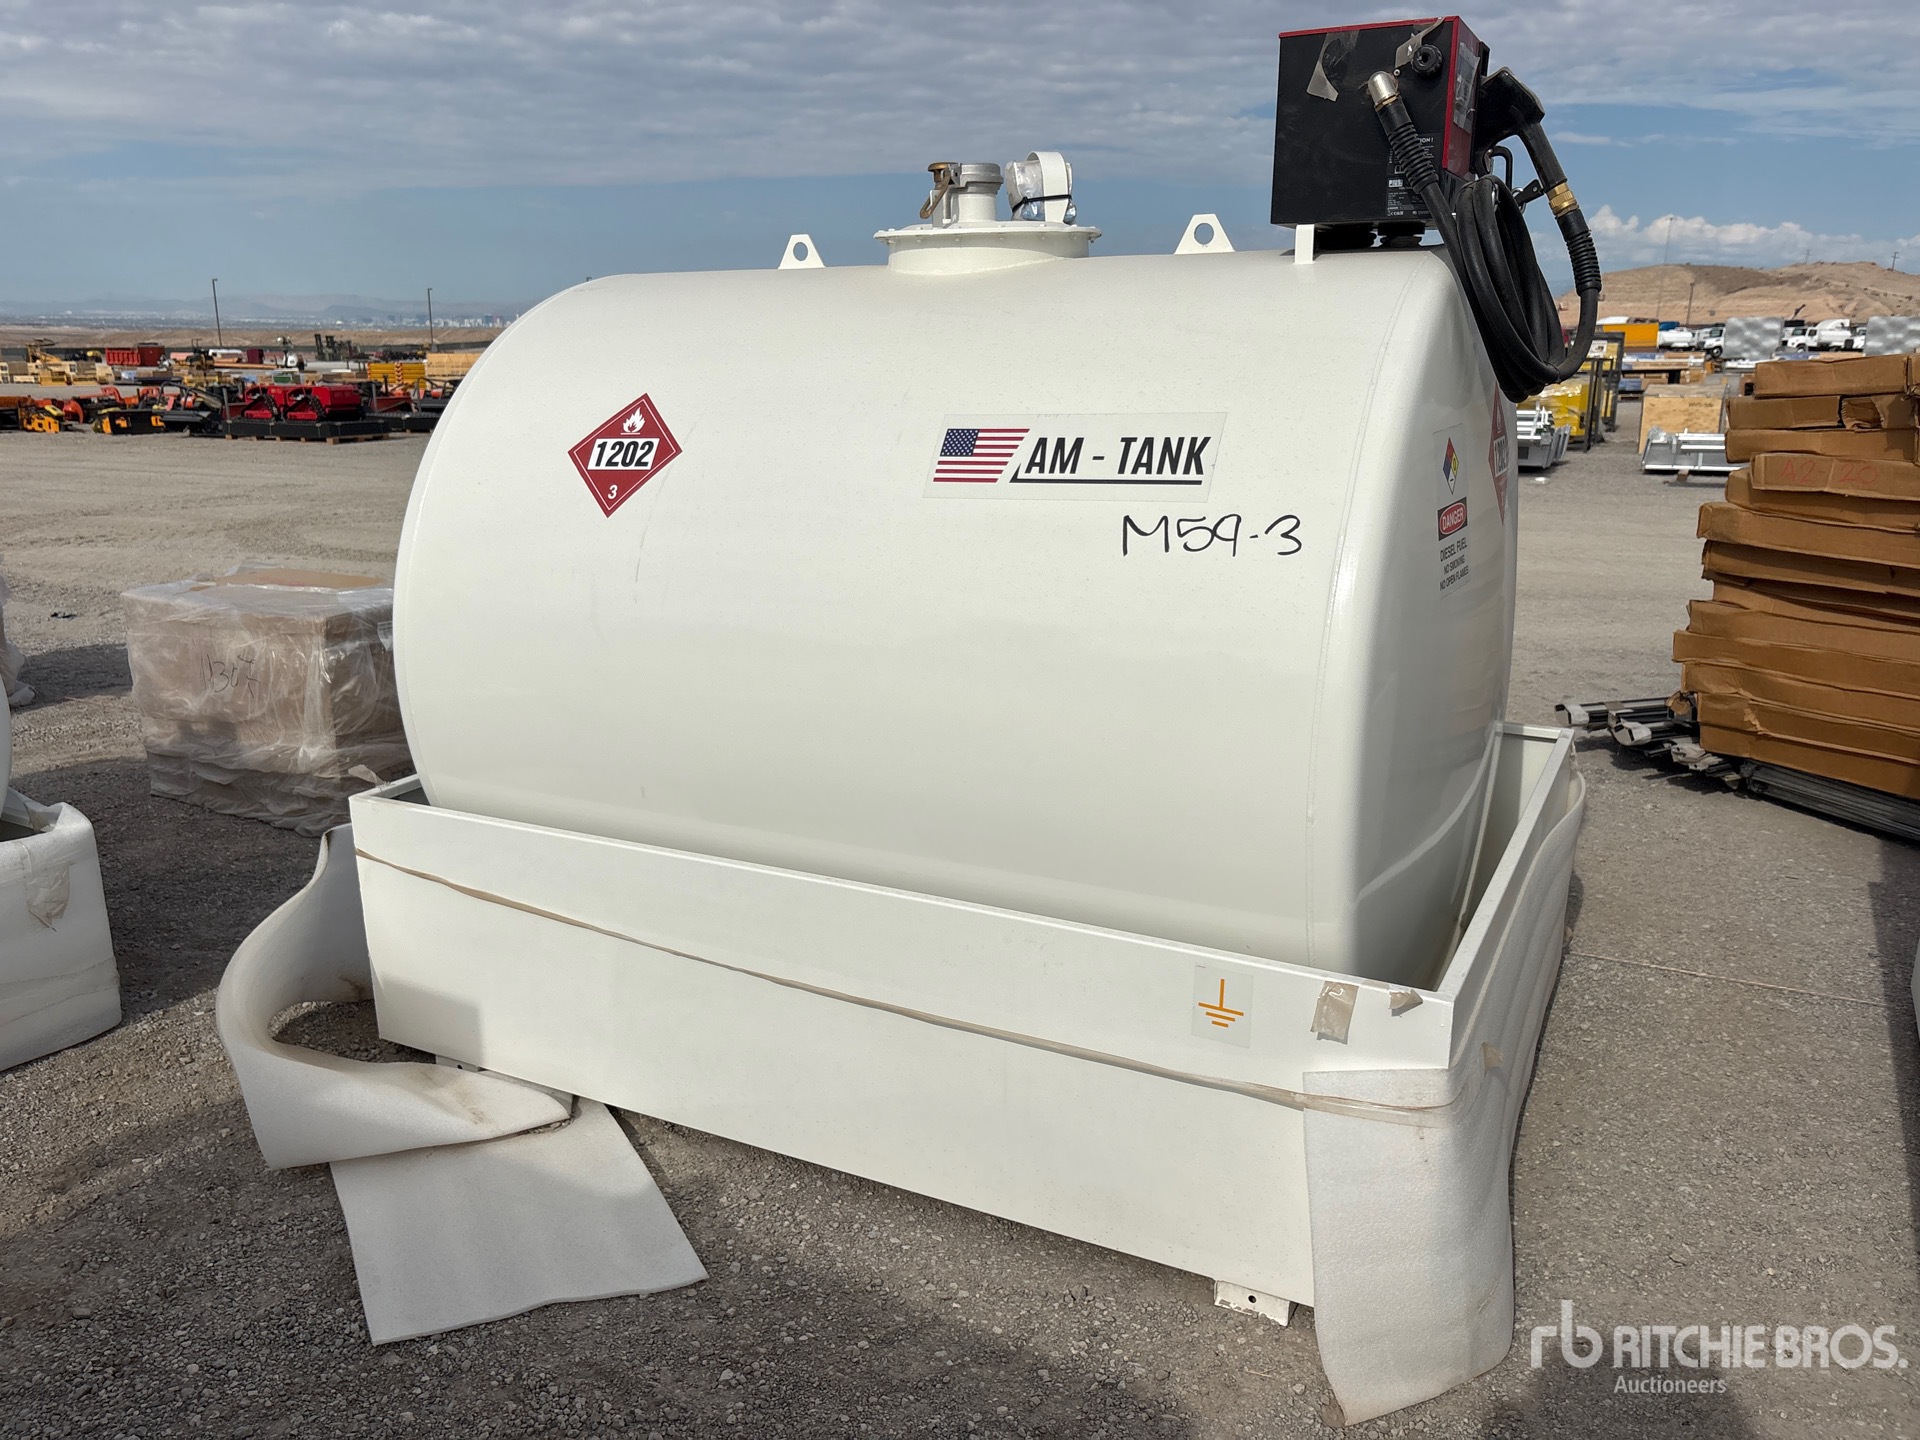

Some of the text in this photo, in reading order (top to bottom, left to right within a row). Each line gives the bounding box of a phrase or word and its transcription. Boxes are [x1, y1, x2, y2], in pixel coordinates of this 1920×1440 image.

[595, 440, 655, 468] 1202
[1024, 436, 1085, 475] AM
[1117, 436, 1212, 475] TANK
[607, 484, 618, 499] 3
[1442, 507, 1464, 531] DANGER
[1122, 513, 1303, 557] M59-3
[1440, 537, 1467, 562] DIESEL FUEL
